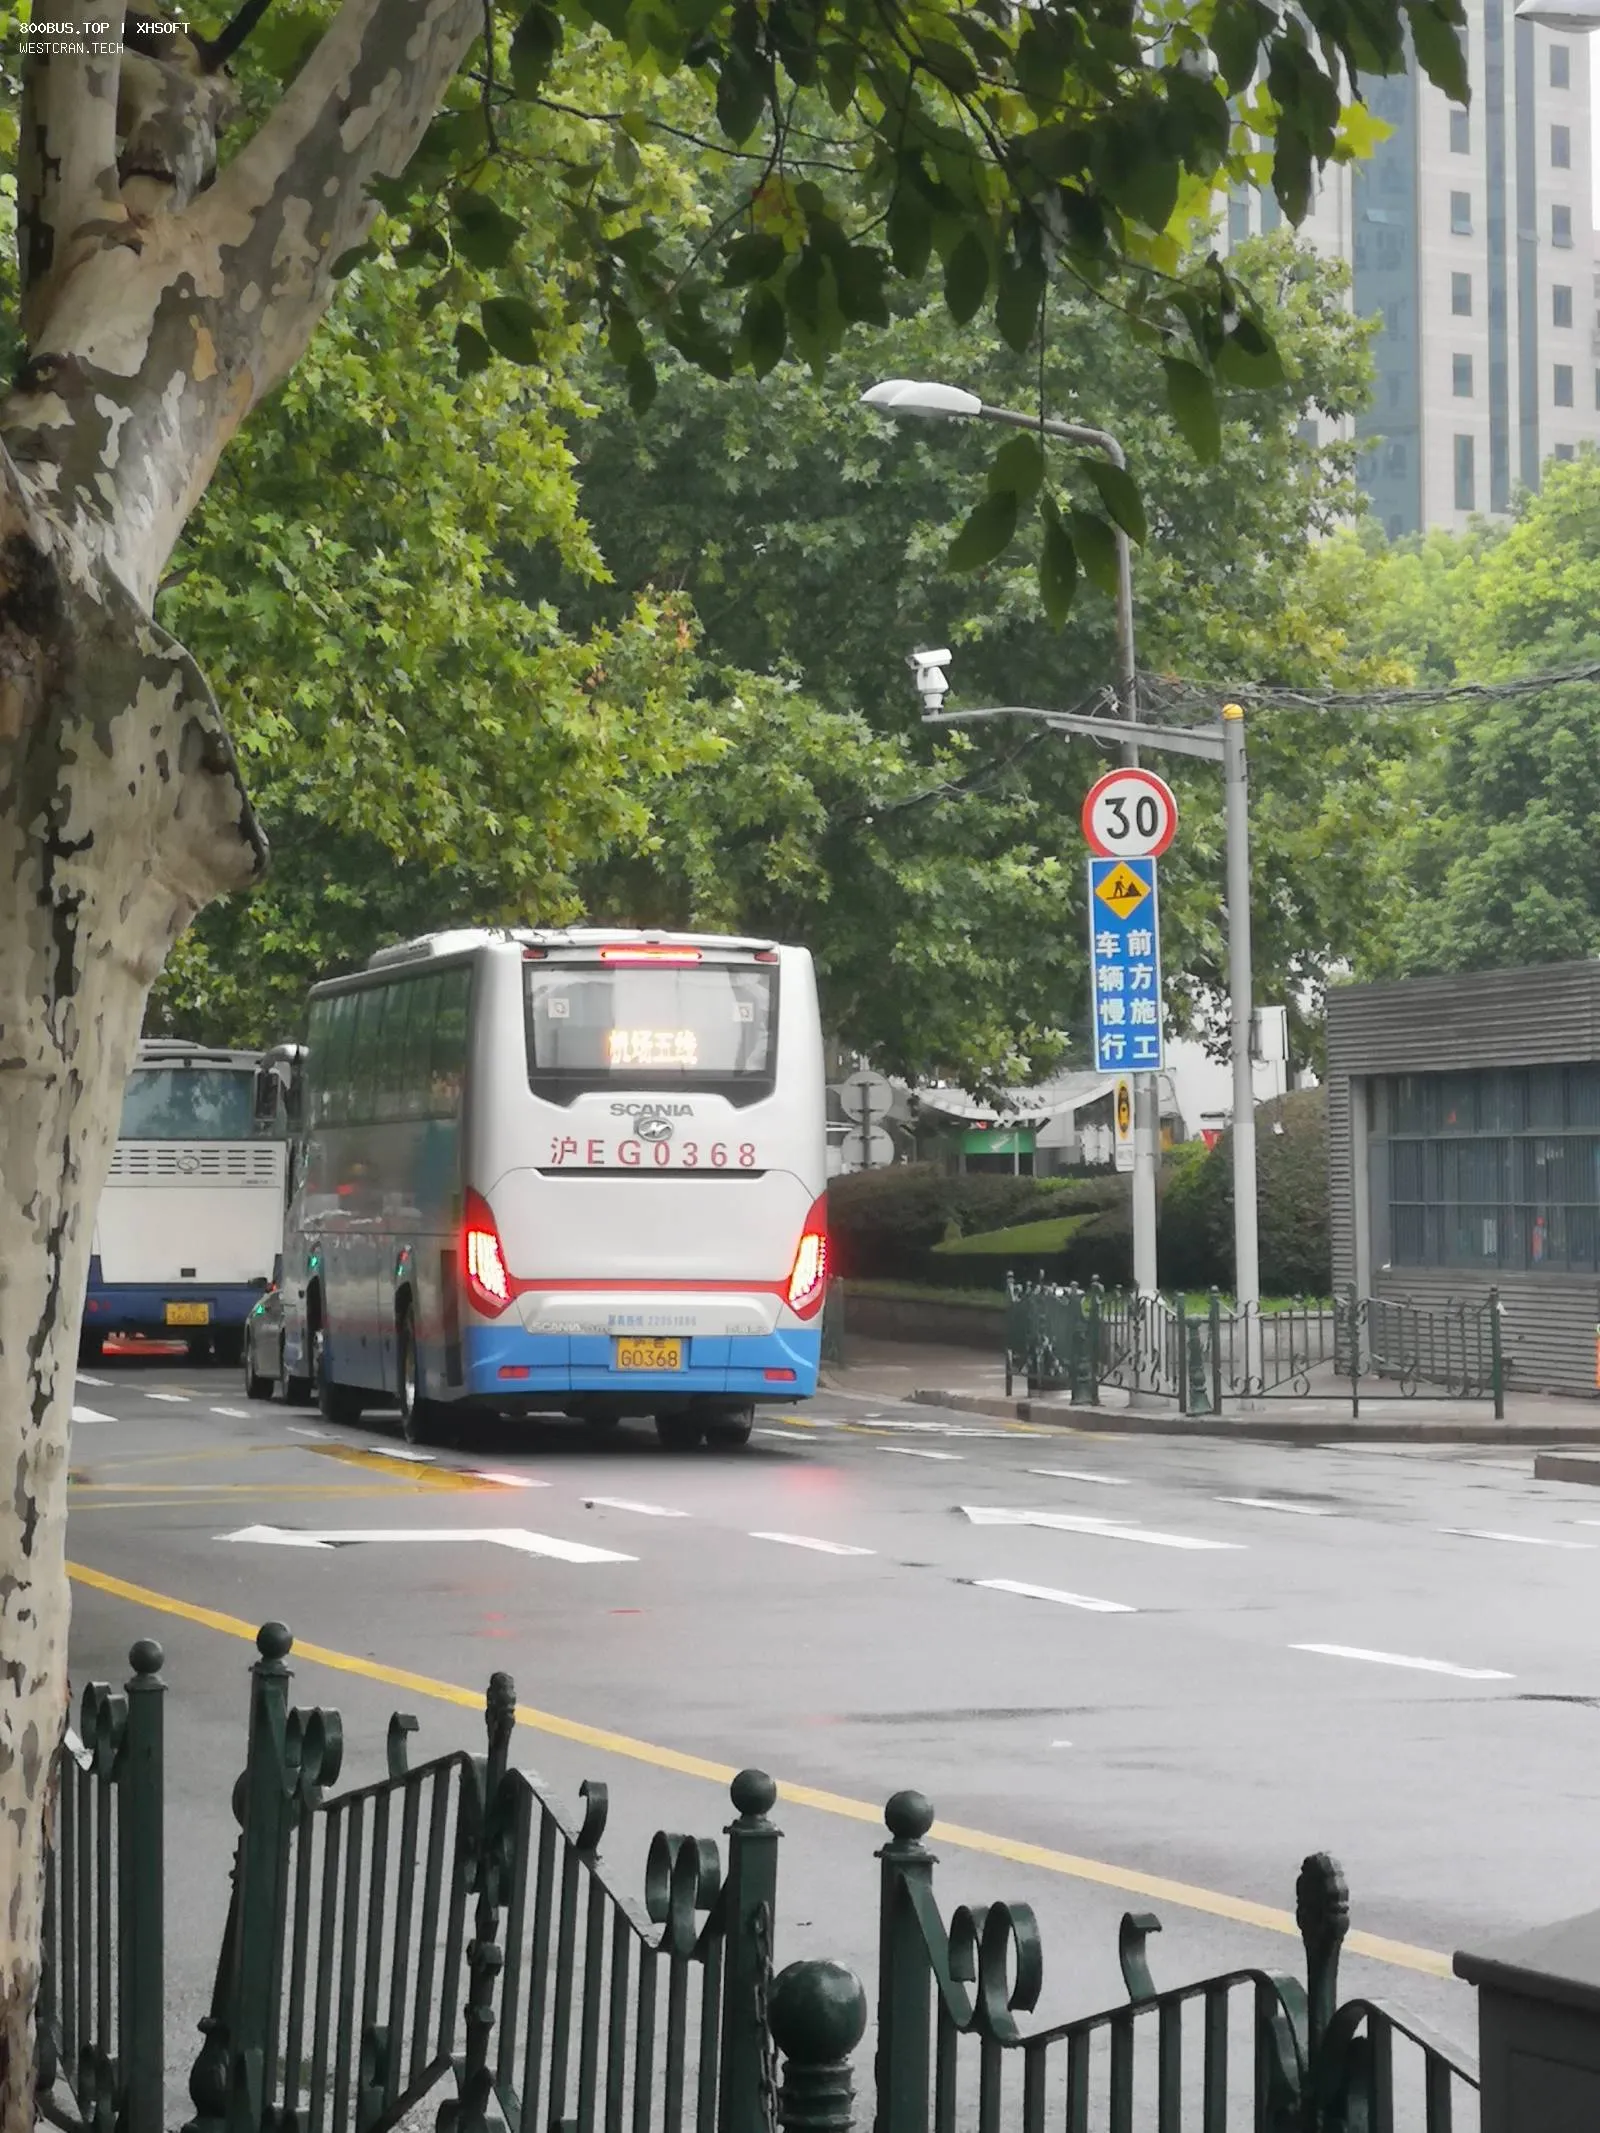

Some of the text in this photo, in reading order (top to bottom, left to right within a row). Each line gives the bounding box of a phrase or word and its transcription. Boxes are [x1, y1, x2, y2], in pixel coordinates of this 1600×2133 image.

[1105, 796, 1159, 839] 30
[1096, 930, 1127, 1061] 车辆慢行
[1126, 928, 1158, 1060] 前方施工
[609, 1103, 694, 1117] SCANIA
[551, 1136, 756, 1168] 沪EG0368
[621, 1350, 678, 1367] G0368
